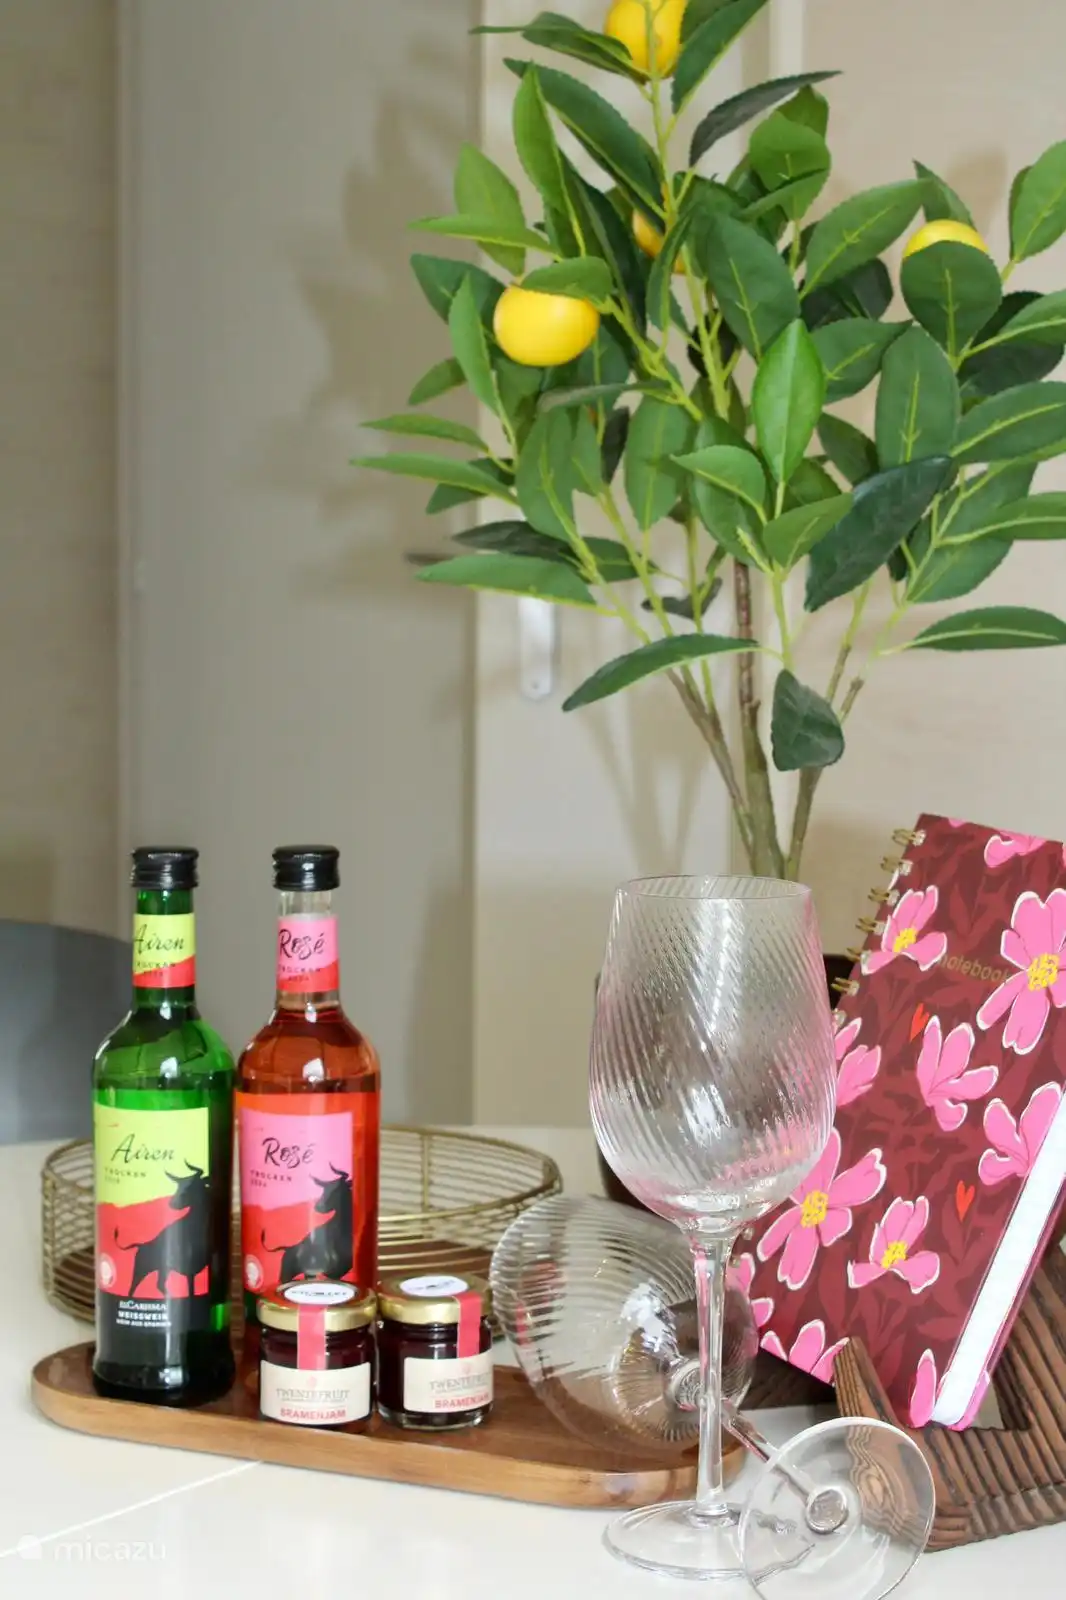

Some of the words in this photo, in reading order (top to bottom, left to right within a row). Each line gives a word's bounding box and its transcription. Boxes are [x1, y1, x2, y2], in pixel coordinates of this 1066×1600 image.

[278, 928, 325, 960] Rosé
[111, 1133, 175, 1164] Airen
[262, 1137, 317, 1169] Rosé
[249, 1169, 292, 1181] TROCKEN
[280, 1407, 346, 1419] BRAMENJAM
